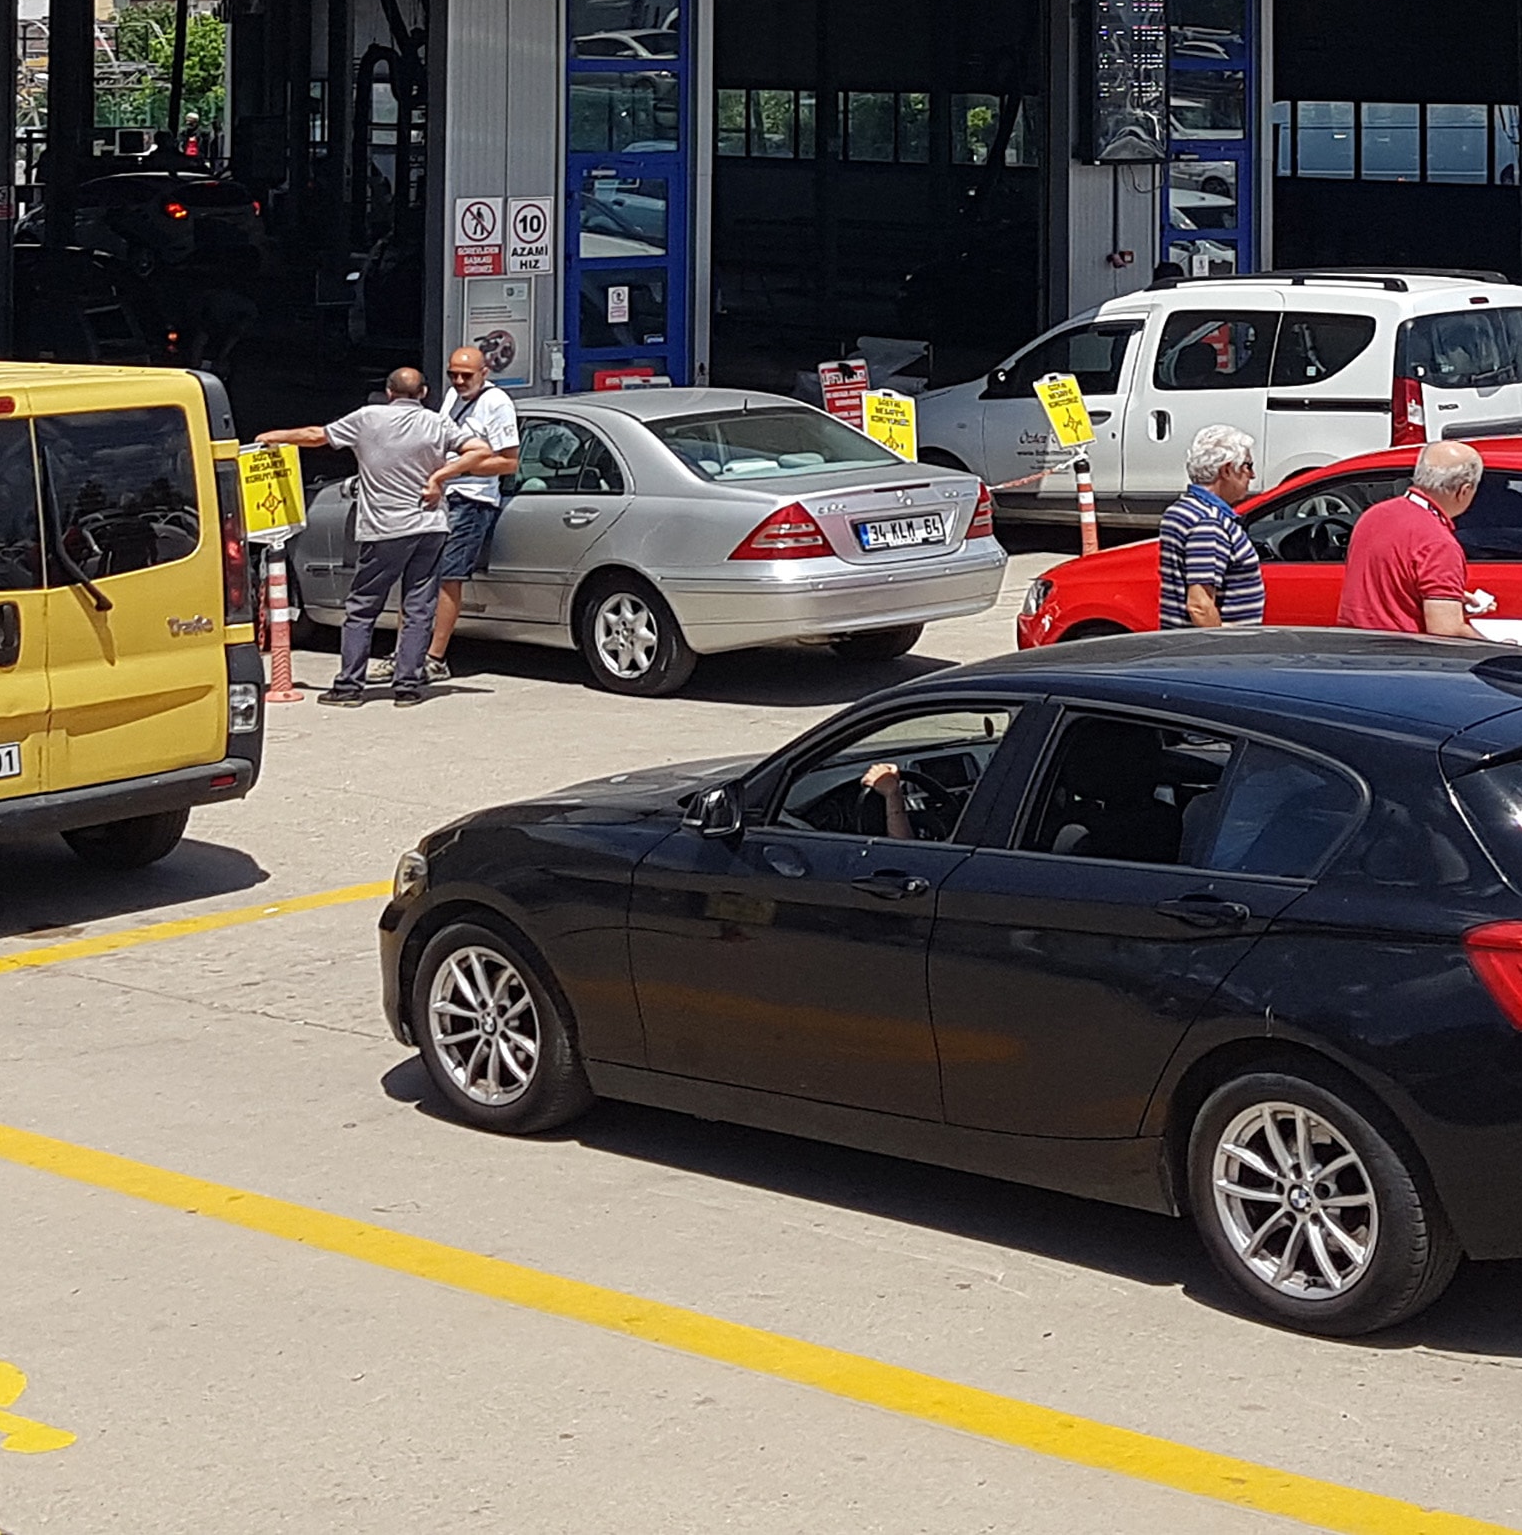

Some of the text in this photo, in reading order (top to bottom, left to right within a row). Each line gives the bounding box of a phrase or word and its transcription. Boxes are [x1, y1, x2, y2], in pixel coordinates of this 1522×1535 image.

[518, 214, 542, 234] 10
[511, 244, 548, 257] AZAMİ
[520, 259, 540, 269] HIZ
[870, 517, 940, 542] 34 KLM 64
